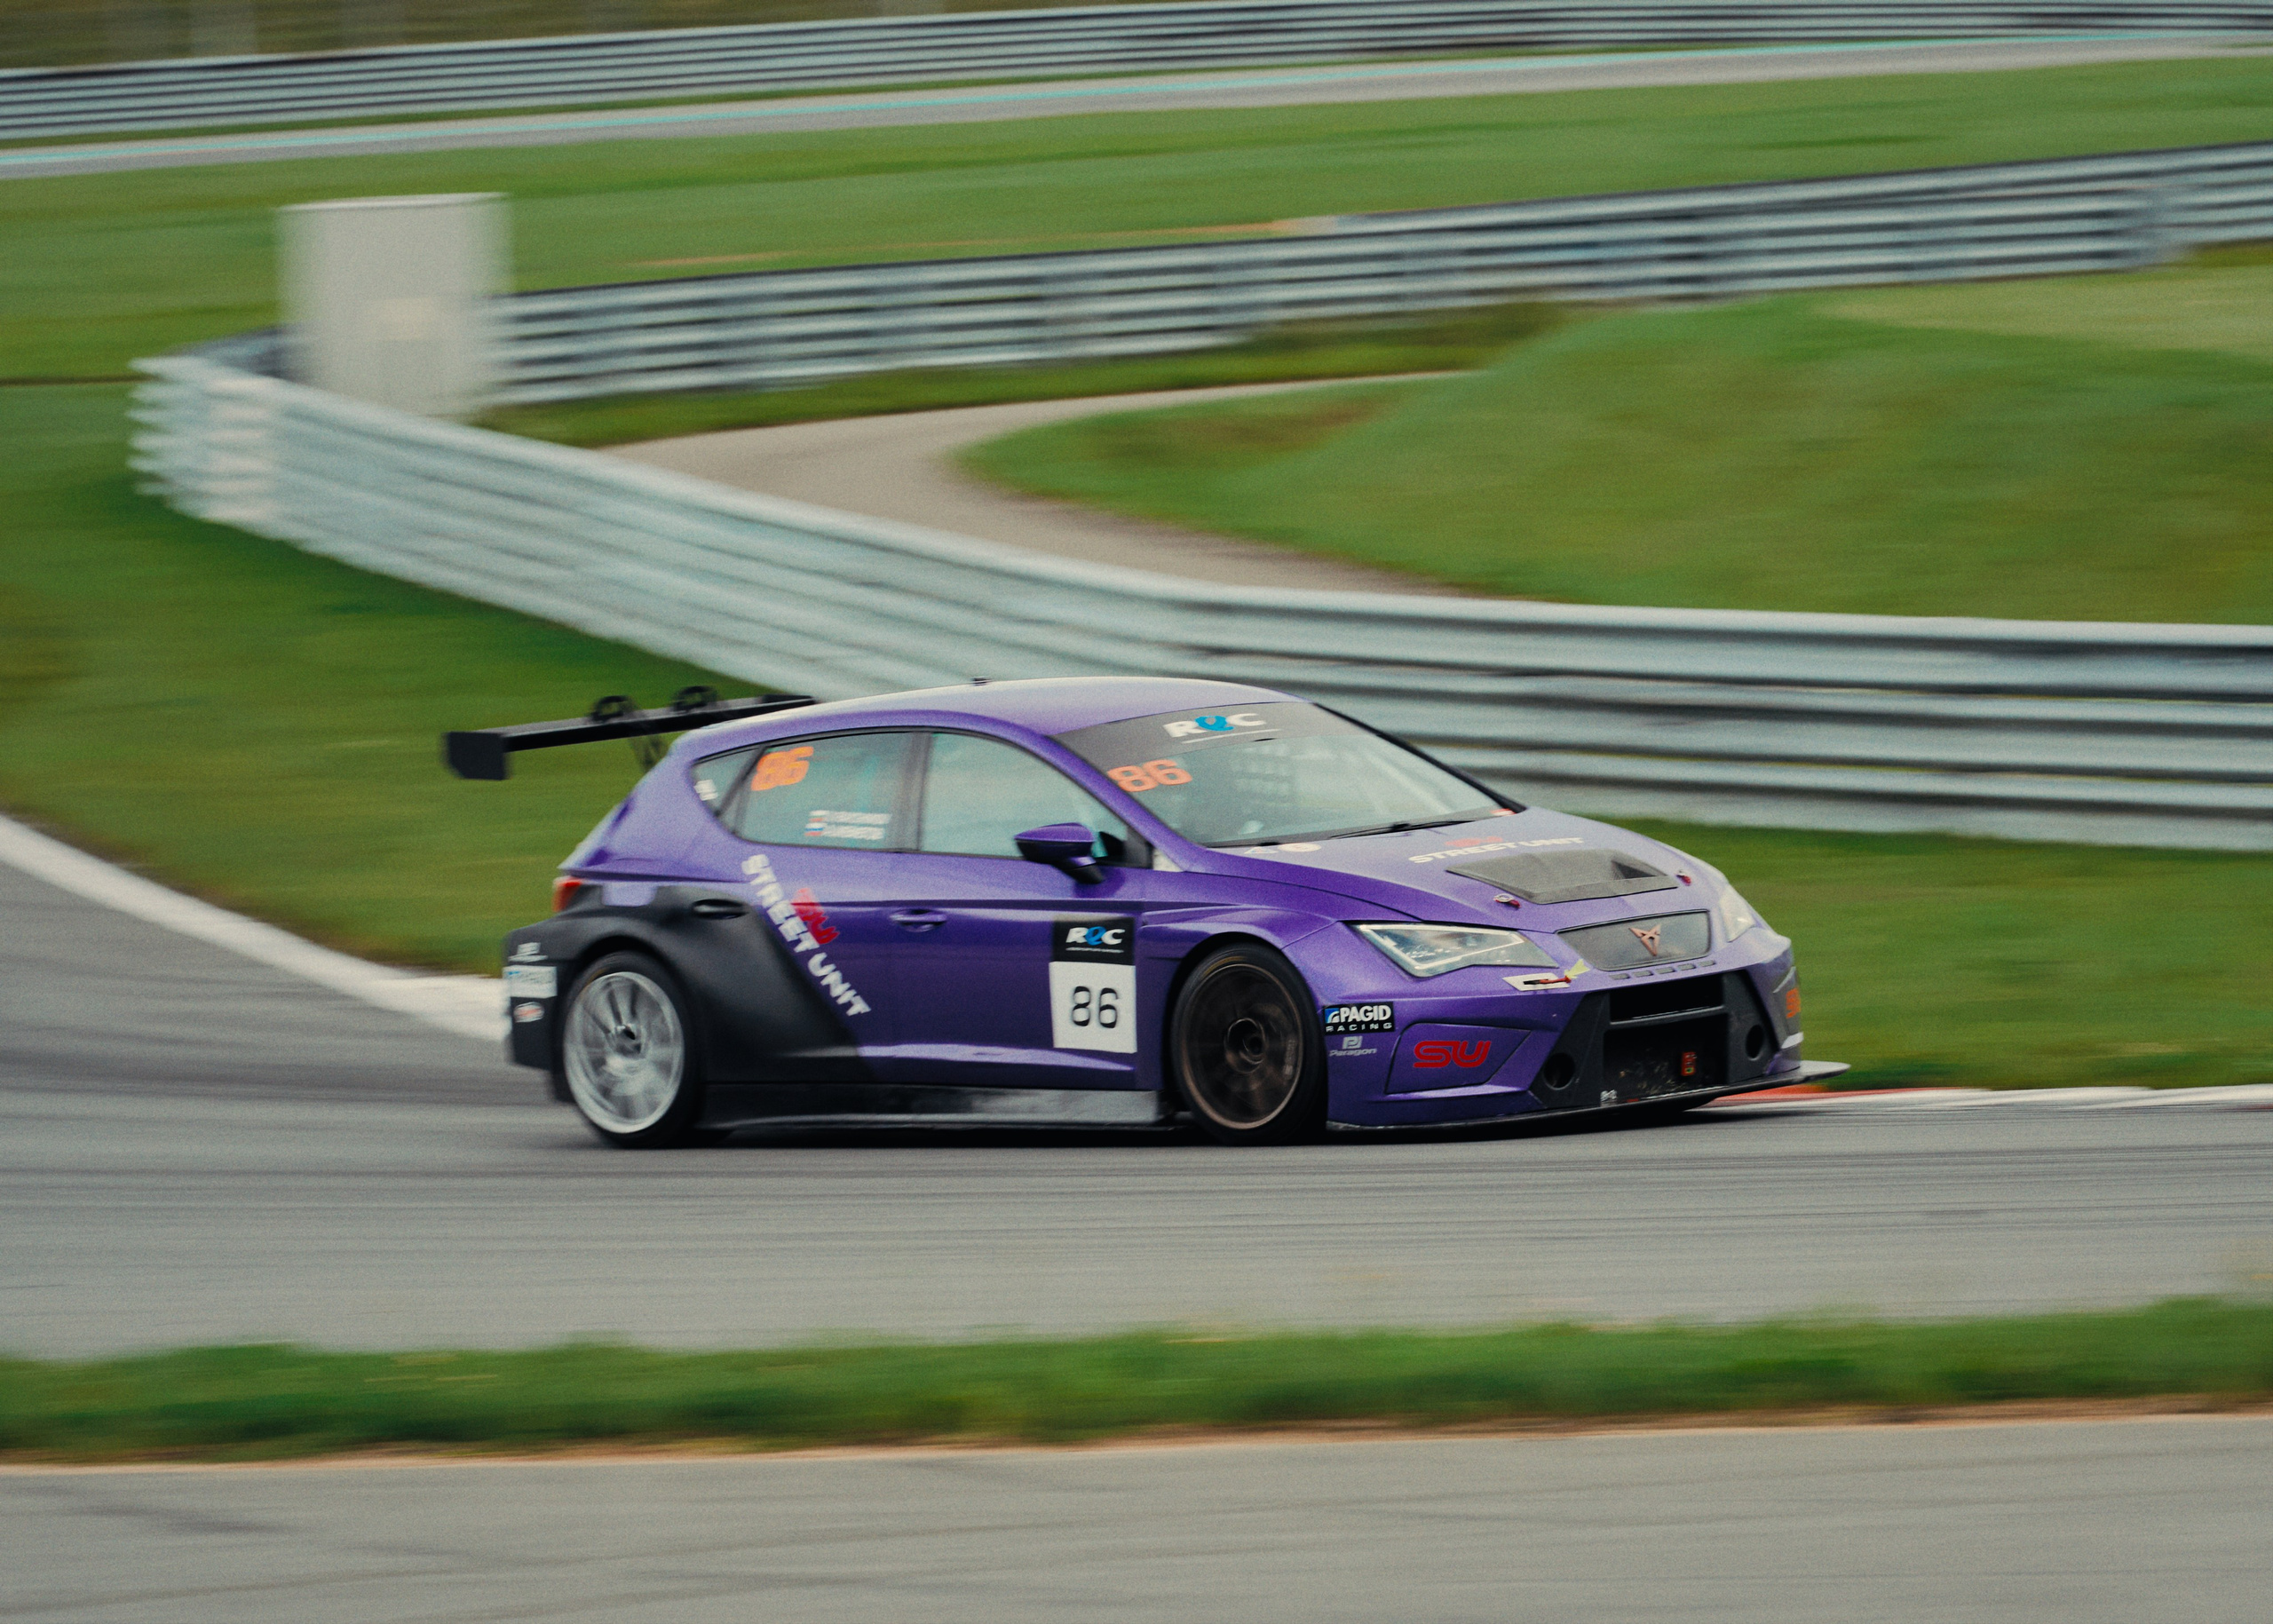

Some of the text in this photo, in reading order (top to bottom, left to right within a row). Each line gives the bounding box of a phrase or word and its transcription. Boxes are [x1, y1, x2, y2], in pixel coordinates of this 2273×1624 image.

[1107, 759, 1192, 792] 86
[1408, 842, 1518, 864] STREET
[741, 853, 872, 1017] STREET UNIT
[1071, 986, 1119, 1028] 86
[1340, 1004, 1391, 1022] PAGID
[1325, 1022, 1392, 1033] RACING
